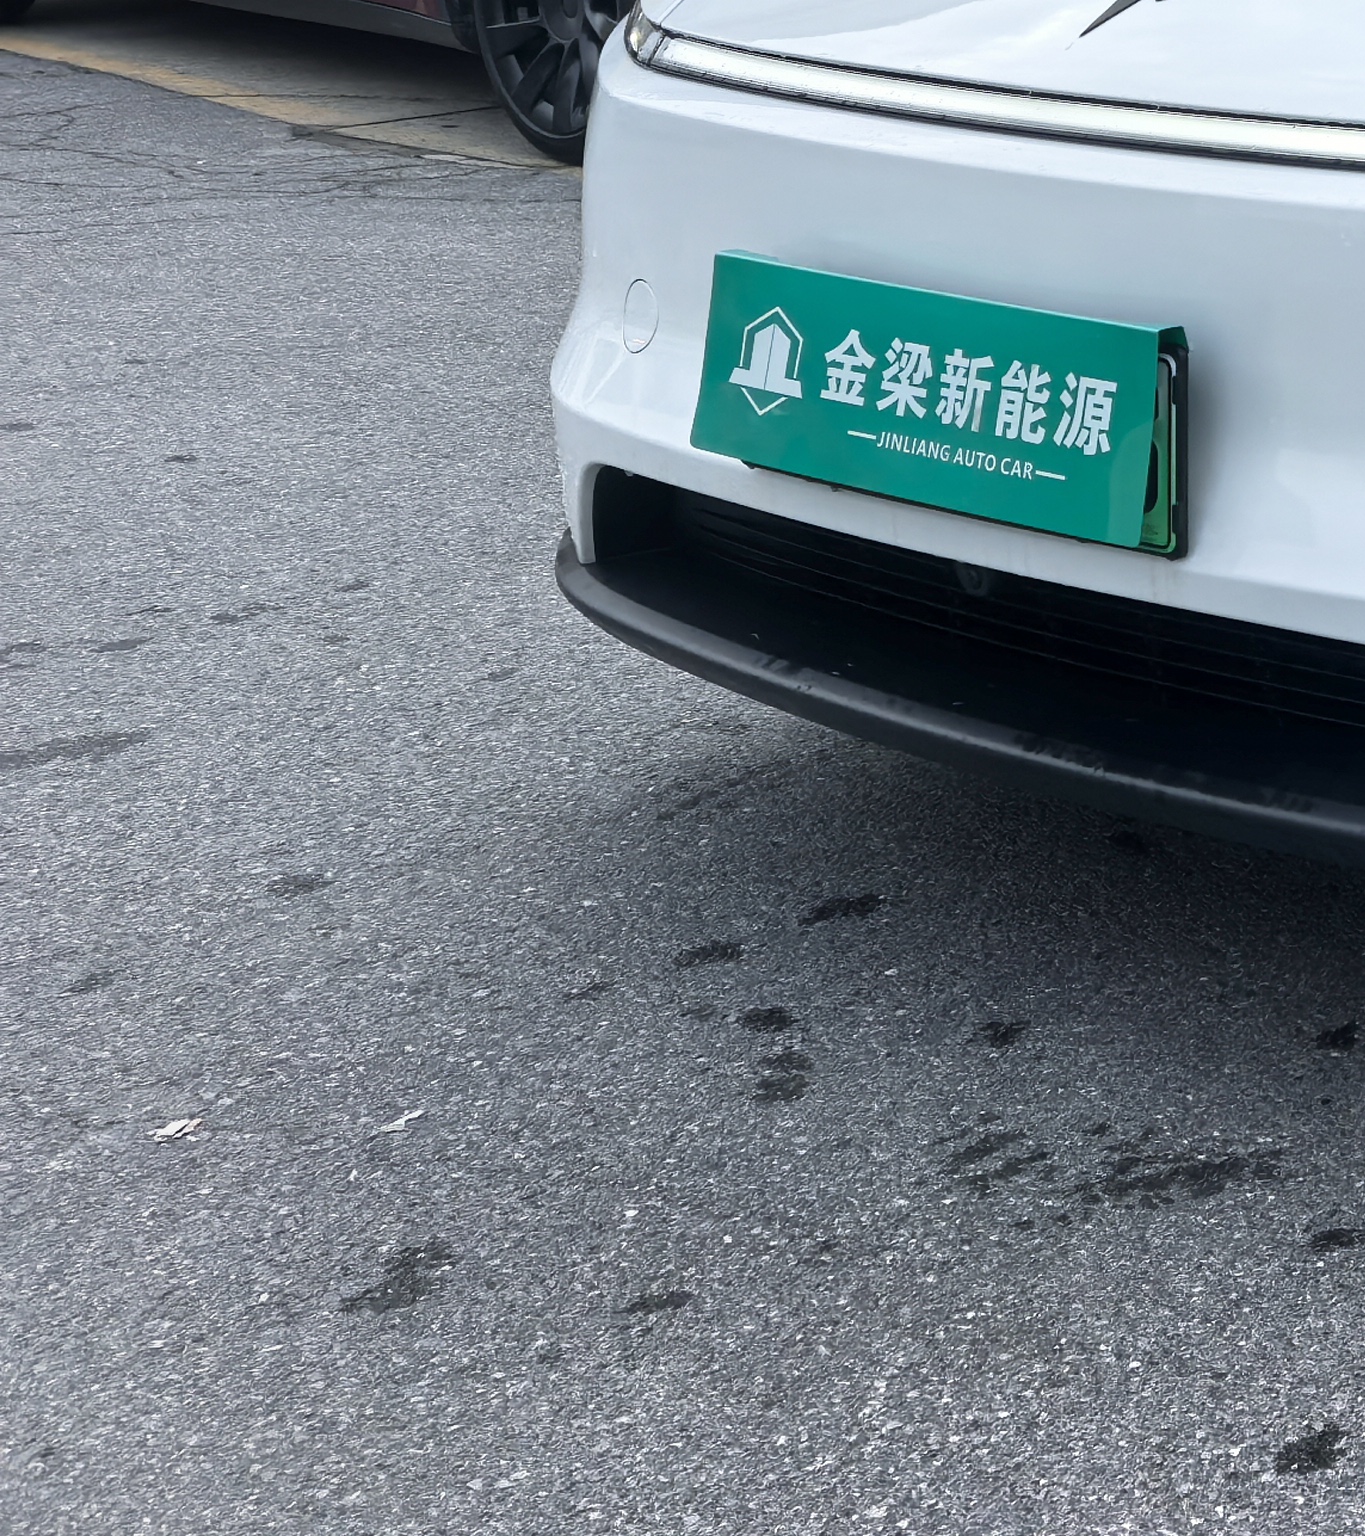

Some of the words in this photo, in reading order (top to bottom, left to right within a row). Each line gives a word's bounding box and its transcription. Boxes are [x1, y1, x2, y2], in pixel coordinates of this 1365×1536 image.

[819, 329, 1118, 456] 金梁新能源
[876, 430, 950, 463] JINLIANG
[953, 446, 997, 472] AUTO
[1000, 457, 1034, 481] CAR
